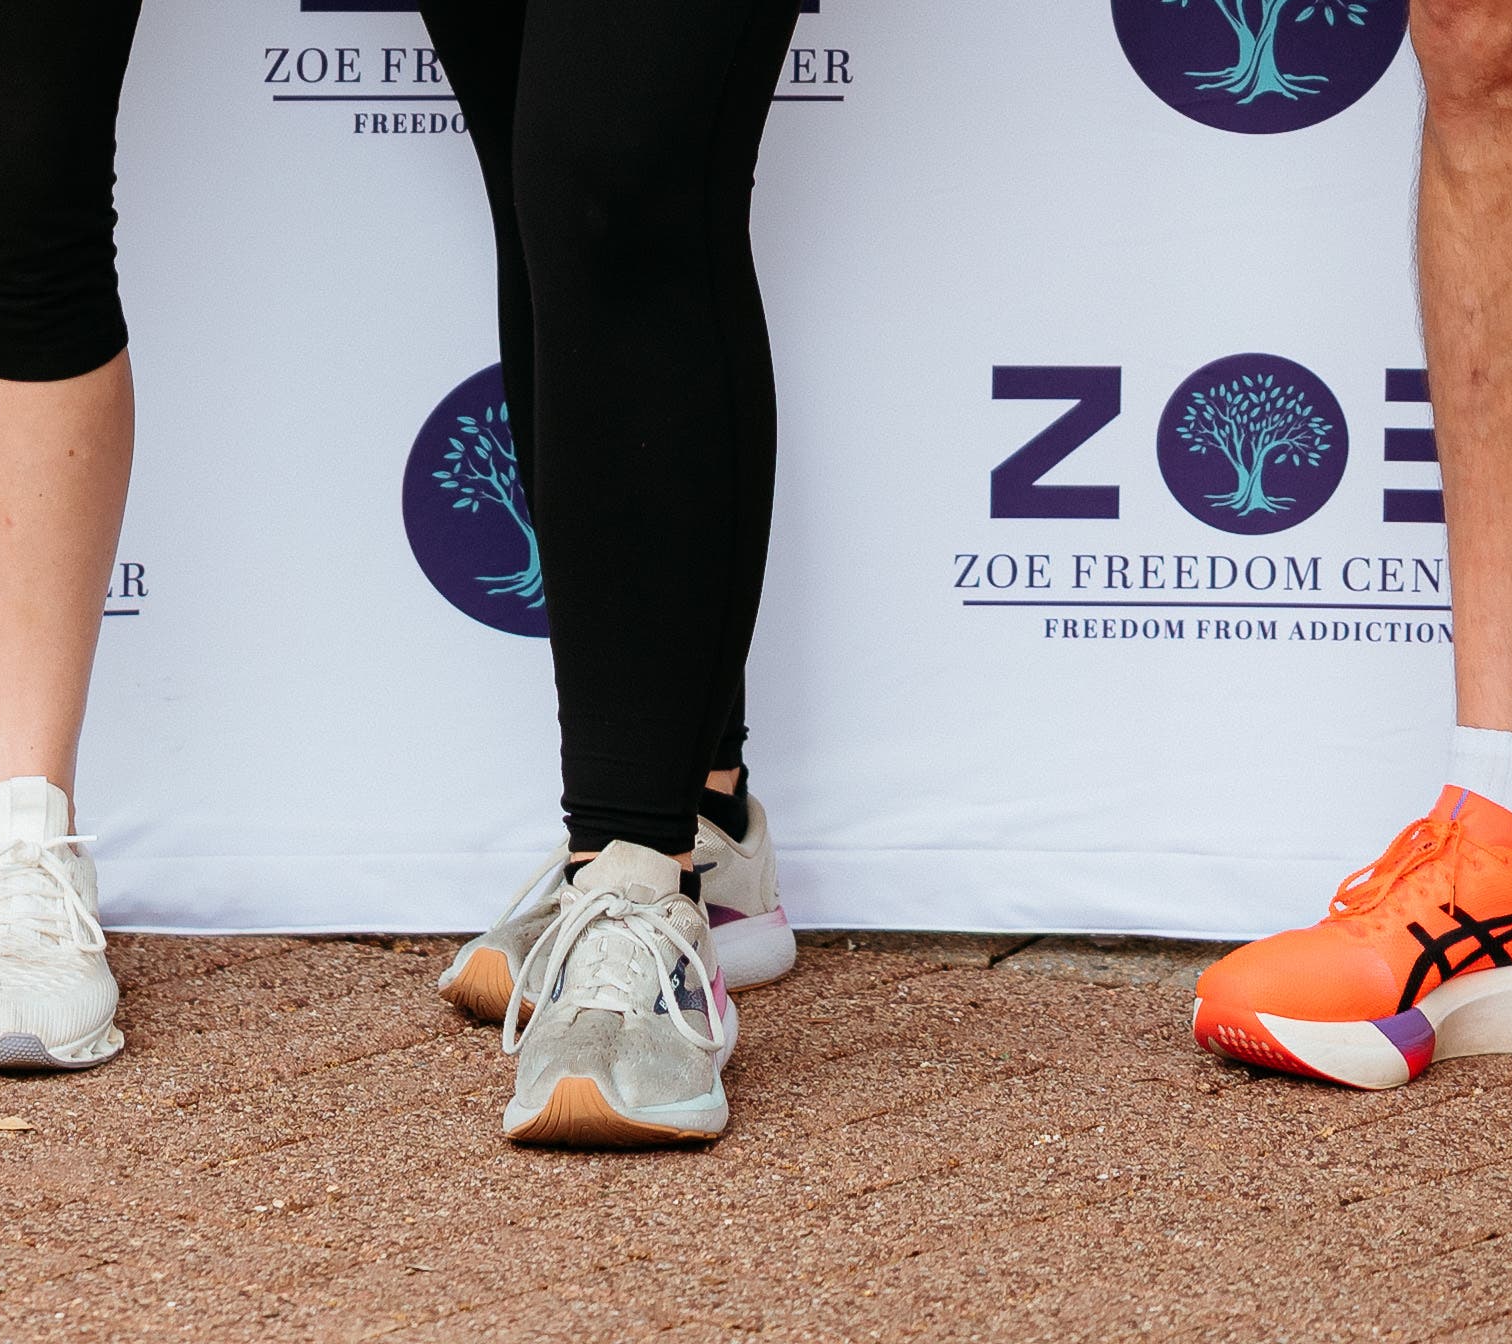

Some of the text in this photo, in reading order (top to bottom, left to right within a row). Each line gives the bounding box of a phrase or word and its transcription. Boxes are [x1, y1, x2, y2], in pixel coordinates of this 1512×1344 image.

[263, 46, 362, 85] ZOE
[353, 111, 467, 135] FREEDO
[952, 552, 1323, 592] ZOE FREEDOM
[1044, 617, 1186, 640] FREEDOM
[1196, 618, 1278, 641] FROM
